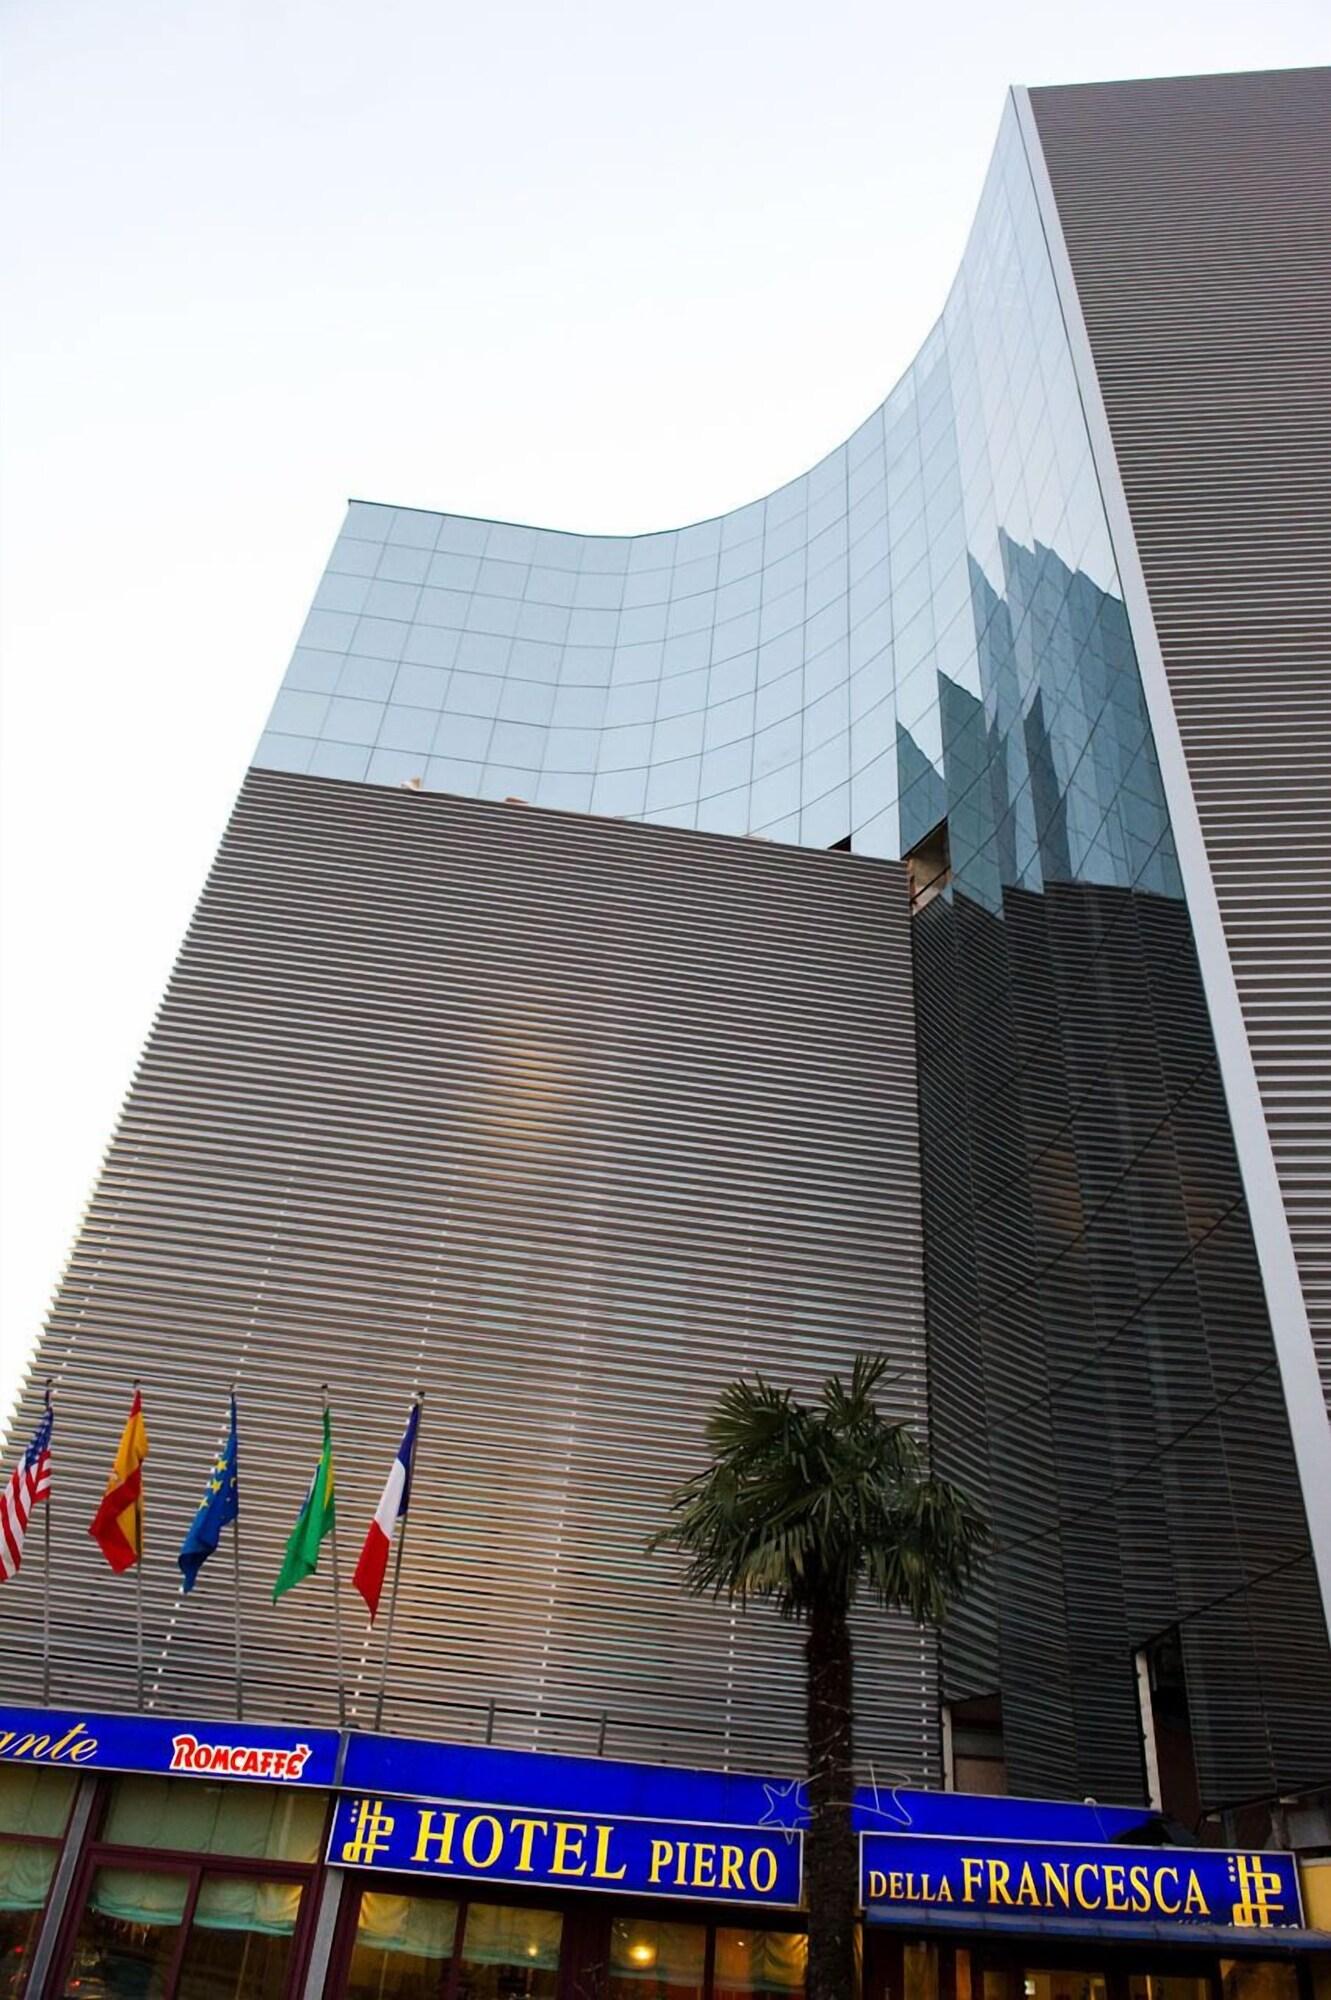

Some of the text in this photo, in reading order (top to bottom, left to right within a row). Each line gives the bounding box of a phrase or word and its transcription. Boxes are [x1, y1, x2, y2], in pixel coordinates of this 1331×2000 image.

[410, 1810, 778, 1892] HOTEL PIERO
[868, 1858, 1211, 1915] DELLA FRANCESCA
